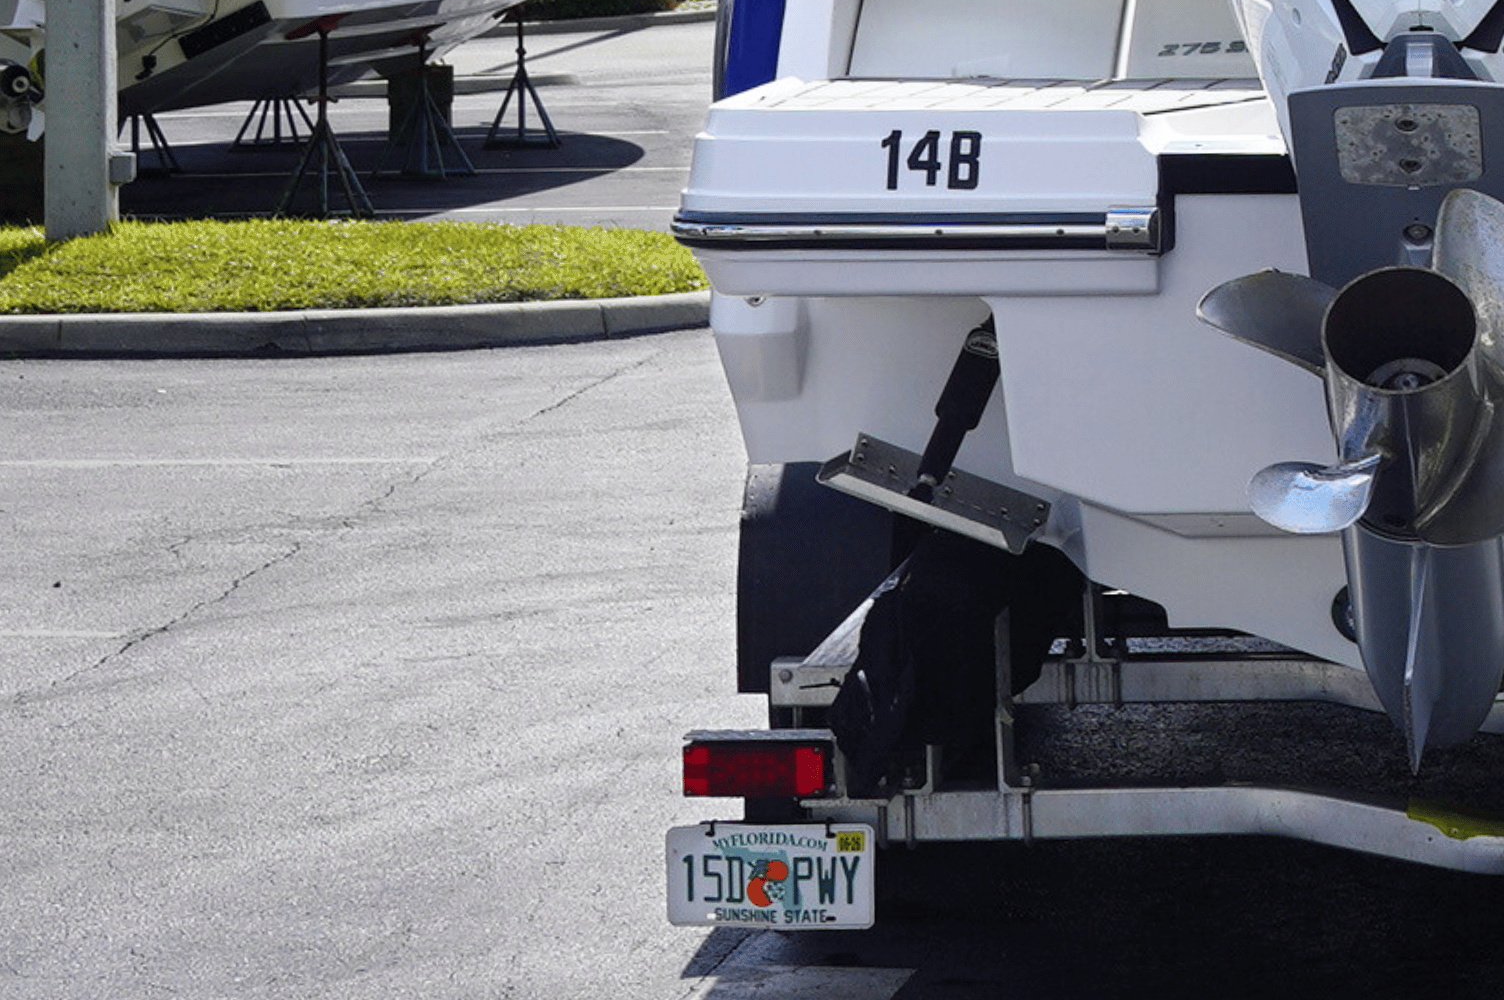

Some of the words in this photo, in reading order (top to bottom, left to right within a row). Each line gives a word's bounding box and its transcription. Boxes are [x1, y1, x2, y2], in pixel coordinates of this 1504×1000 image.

[1158, 41, 1221, 56] 275
[881, 130, 982, 190] 14B
[682, 854, 744, 903] 15D
[793, 856, 861, 906] PWY
[714, 907, 778, 924] SUNSHINE
[783, 909, 828, 924] STATE
